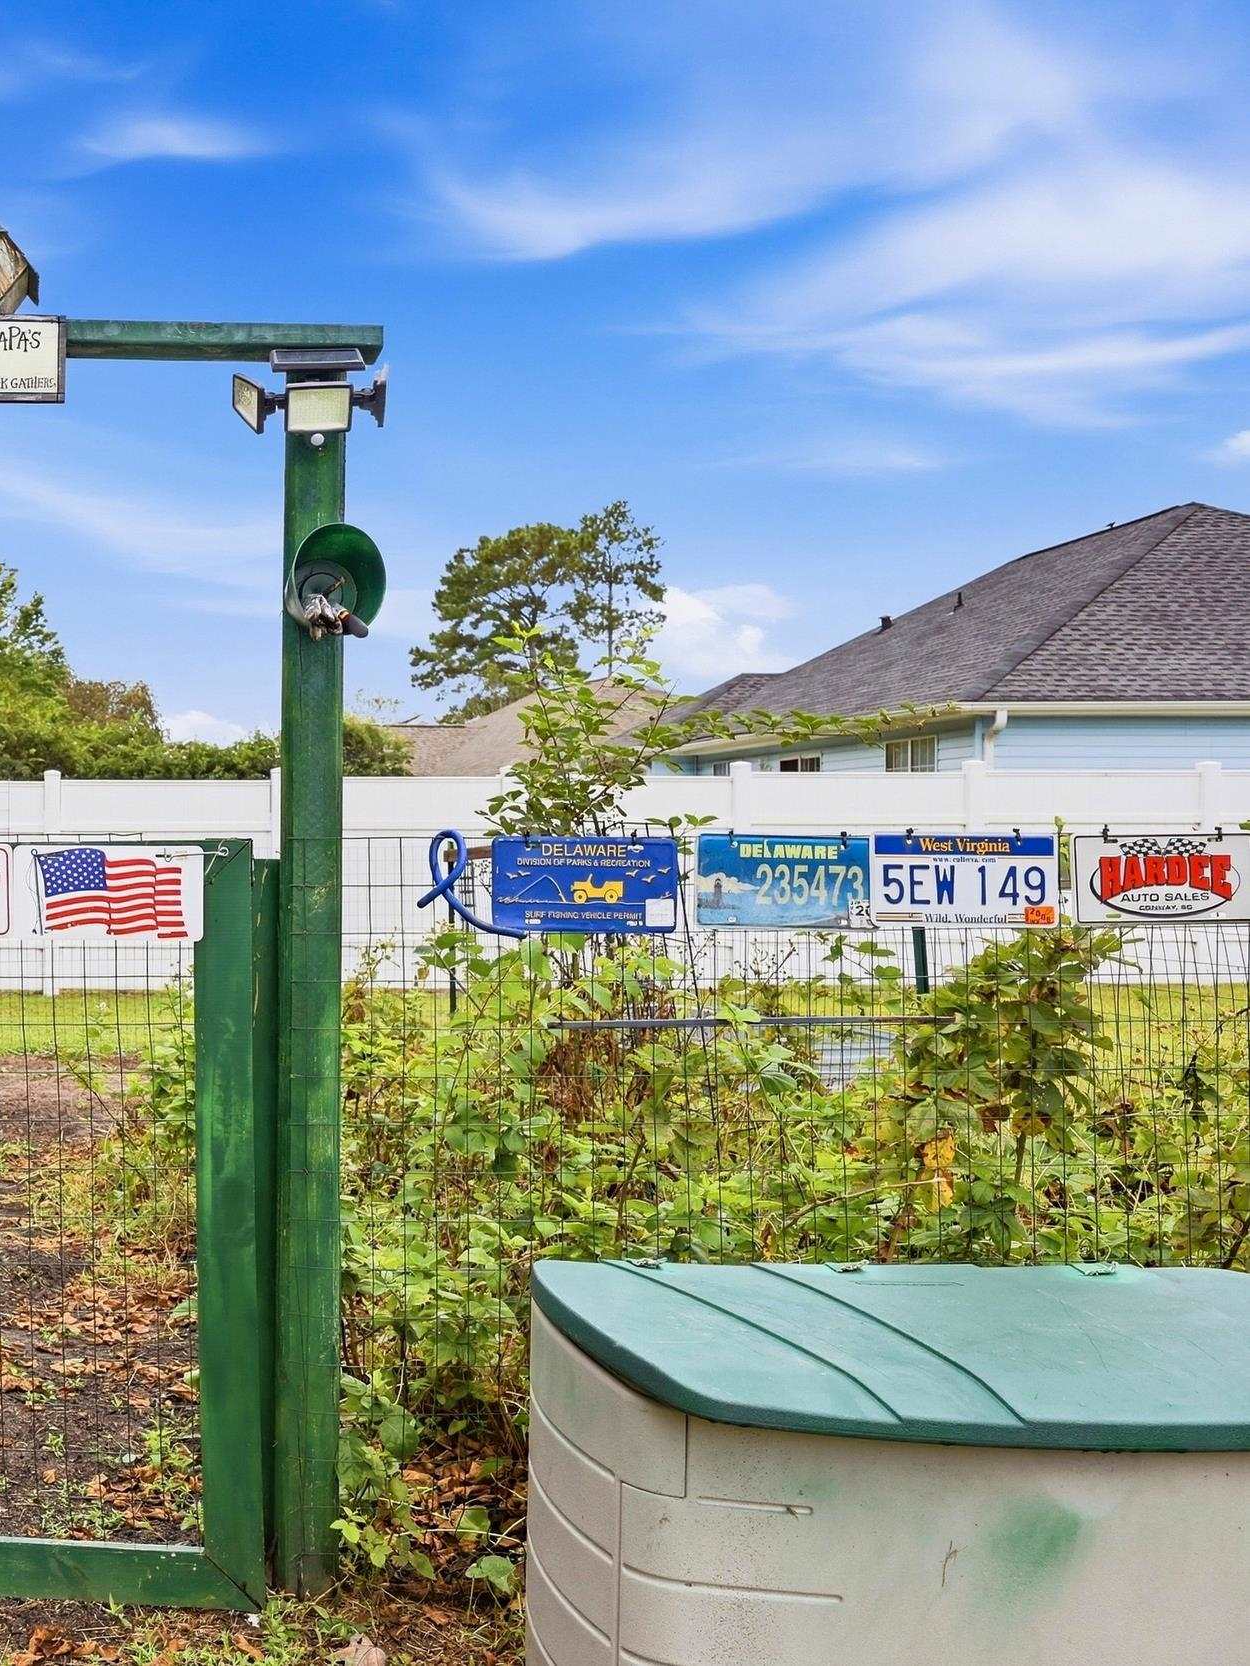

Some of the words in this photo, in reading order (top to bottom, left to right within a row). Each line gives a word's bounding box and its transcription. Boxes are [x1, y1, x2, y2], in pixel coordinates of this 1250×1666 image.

[541, 844, 627, 857] DELAWARE
[740, 843, 838, 859] DELAWARE
[919, 838, 952, 852] West
[955, 838, 1011, 855] Virginia
[517, 858, 551, 866] DIVISION
[553, 858, 565, 866] OF
[600, 859, 651, 867] RECREATION
[756, 863, 864, 906] 235473
[882, 864, 955, 905] 5EW
[978, 865, 1046, 906] 149
[1099, 854, 1232, 902] HARDEE
[1120, 893, 1160, 902] AUTO
[1165, 892, 1210, 901] SALES
[548, 911, 579, 919] FISHING
[614, 912, 643, 920] PERMIT
[954, 913, 1007, 924] Wonderful
